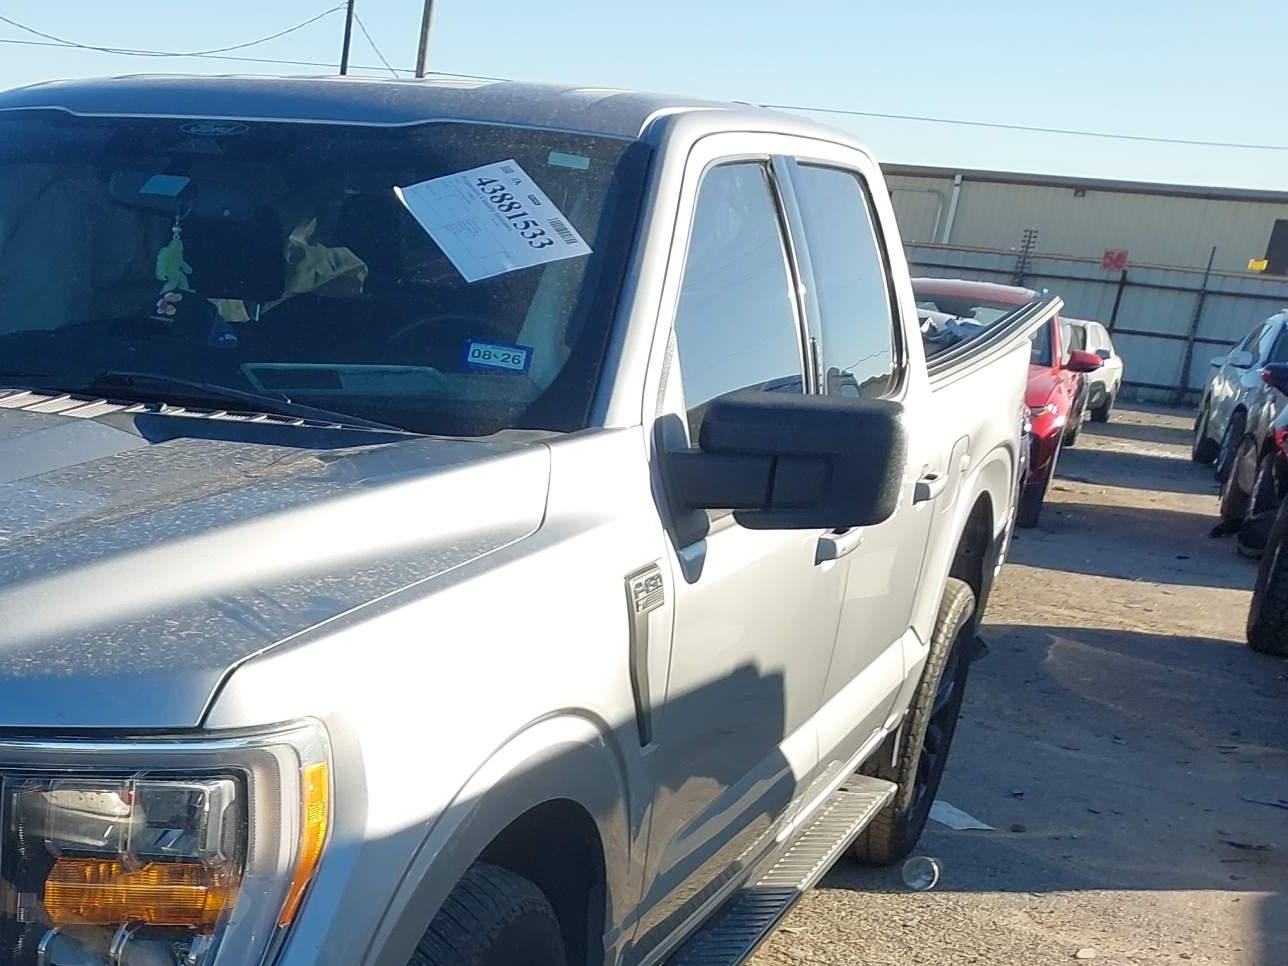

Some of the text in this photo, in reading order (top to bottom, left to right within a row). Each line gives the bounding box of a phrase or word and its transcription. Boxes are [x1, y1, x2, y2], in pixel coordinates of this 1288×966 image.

[476, 178, 554, 249] 43881533
[471, 349, 521, 365] 08 26
